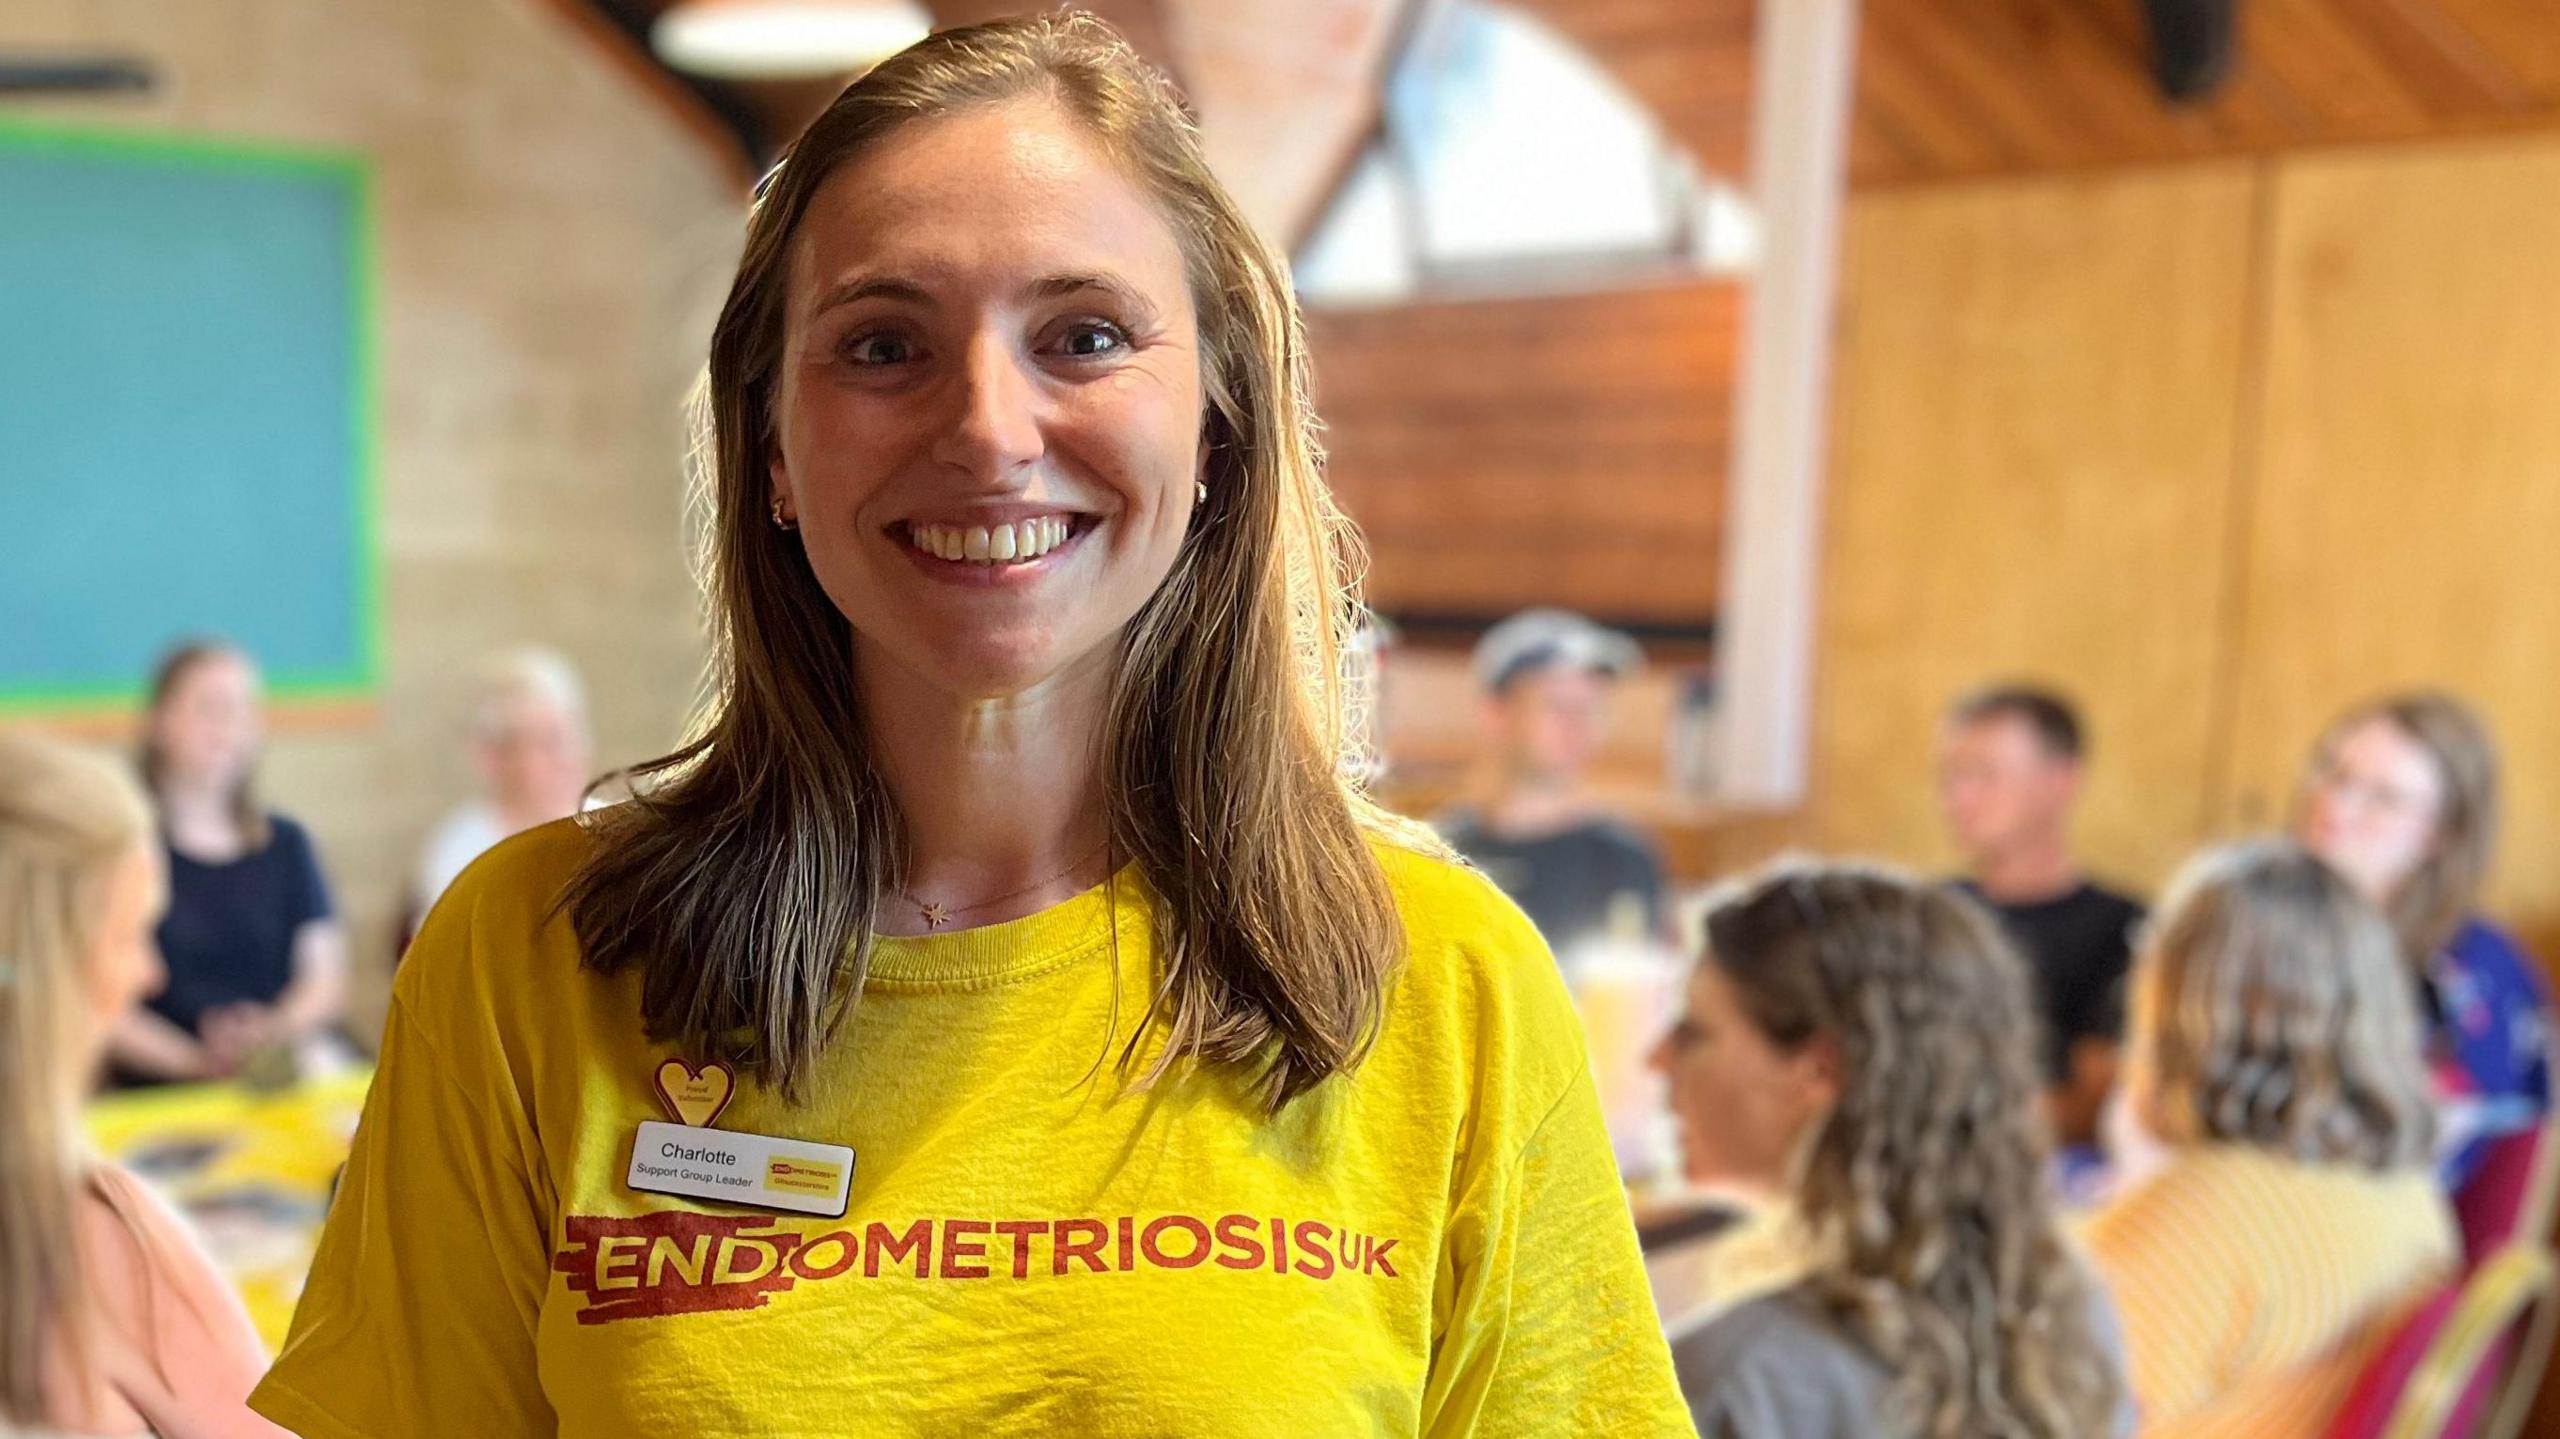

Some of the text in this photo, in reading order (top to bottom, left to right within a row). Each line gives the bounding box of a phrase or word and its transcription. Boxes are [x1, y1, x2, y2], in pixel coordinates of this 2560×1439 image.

[661, 1142, 737, 1166] Charlotte
[636, 1162, 753, 1188] Support Group Leader
